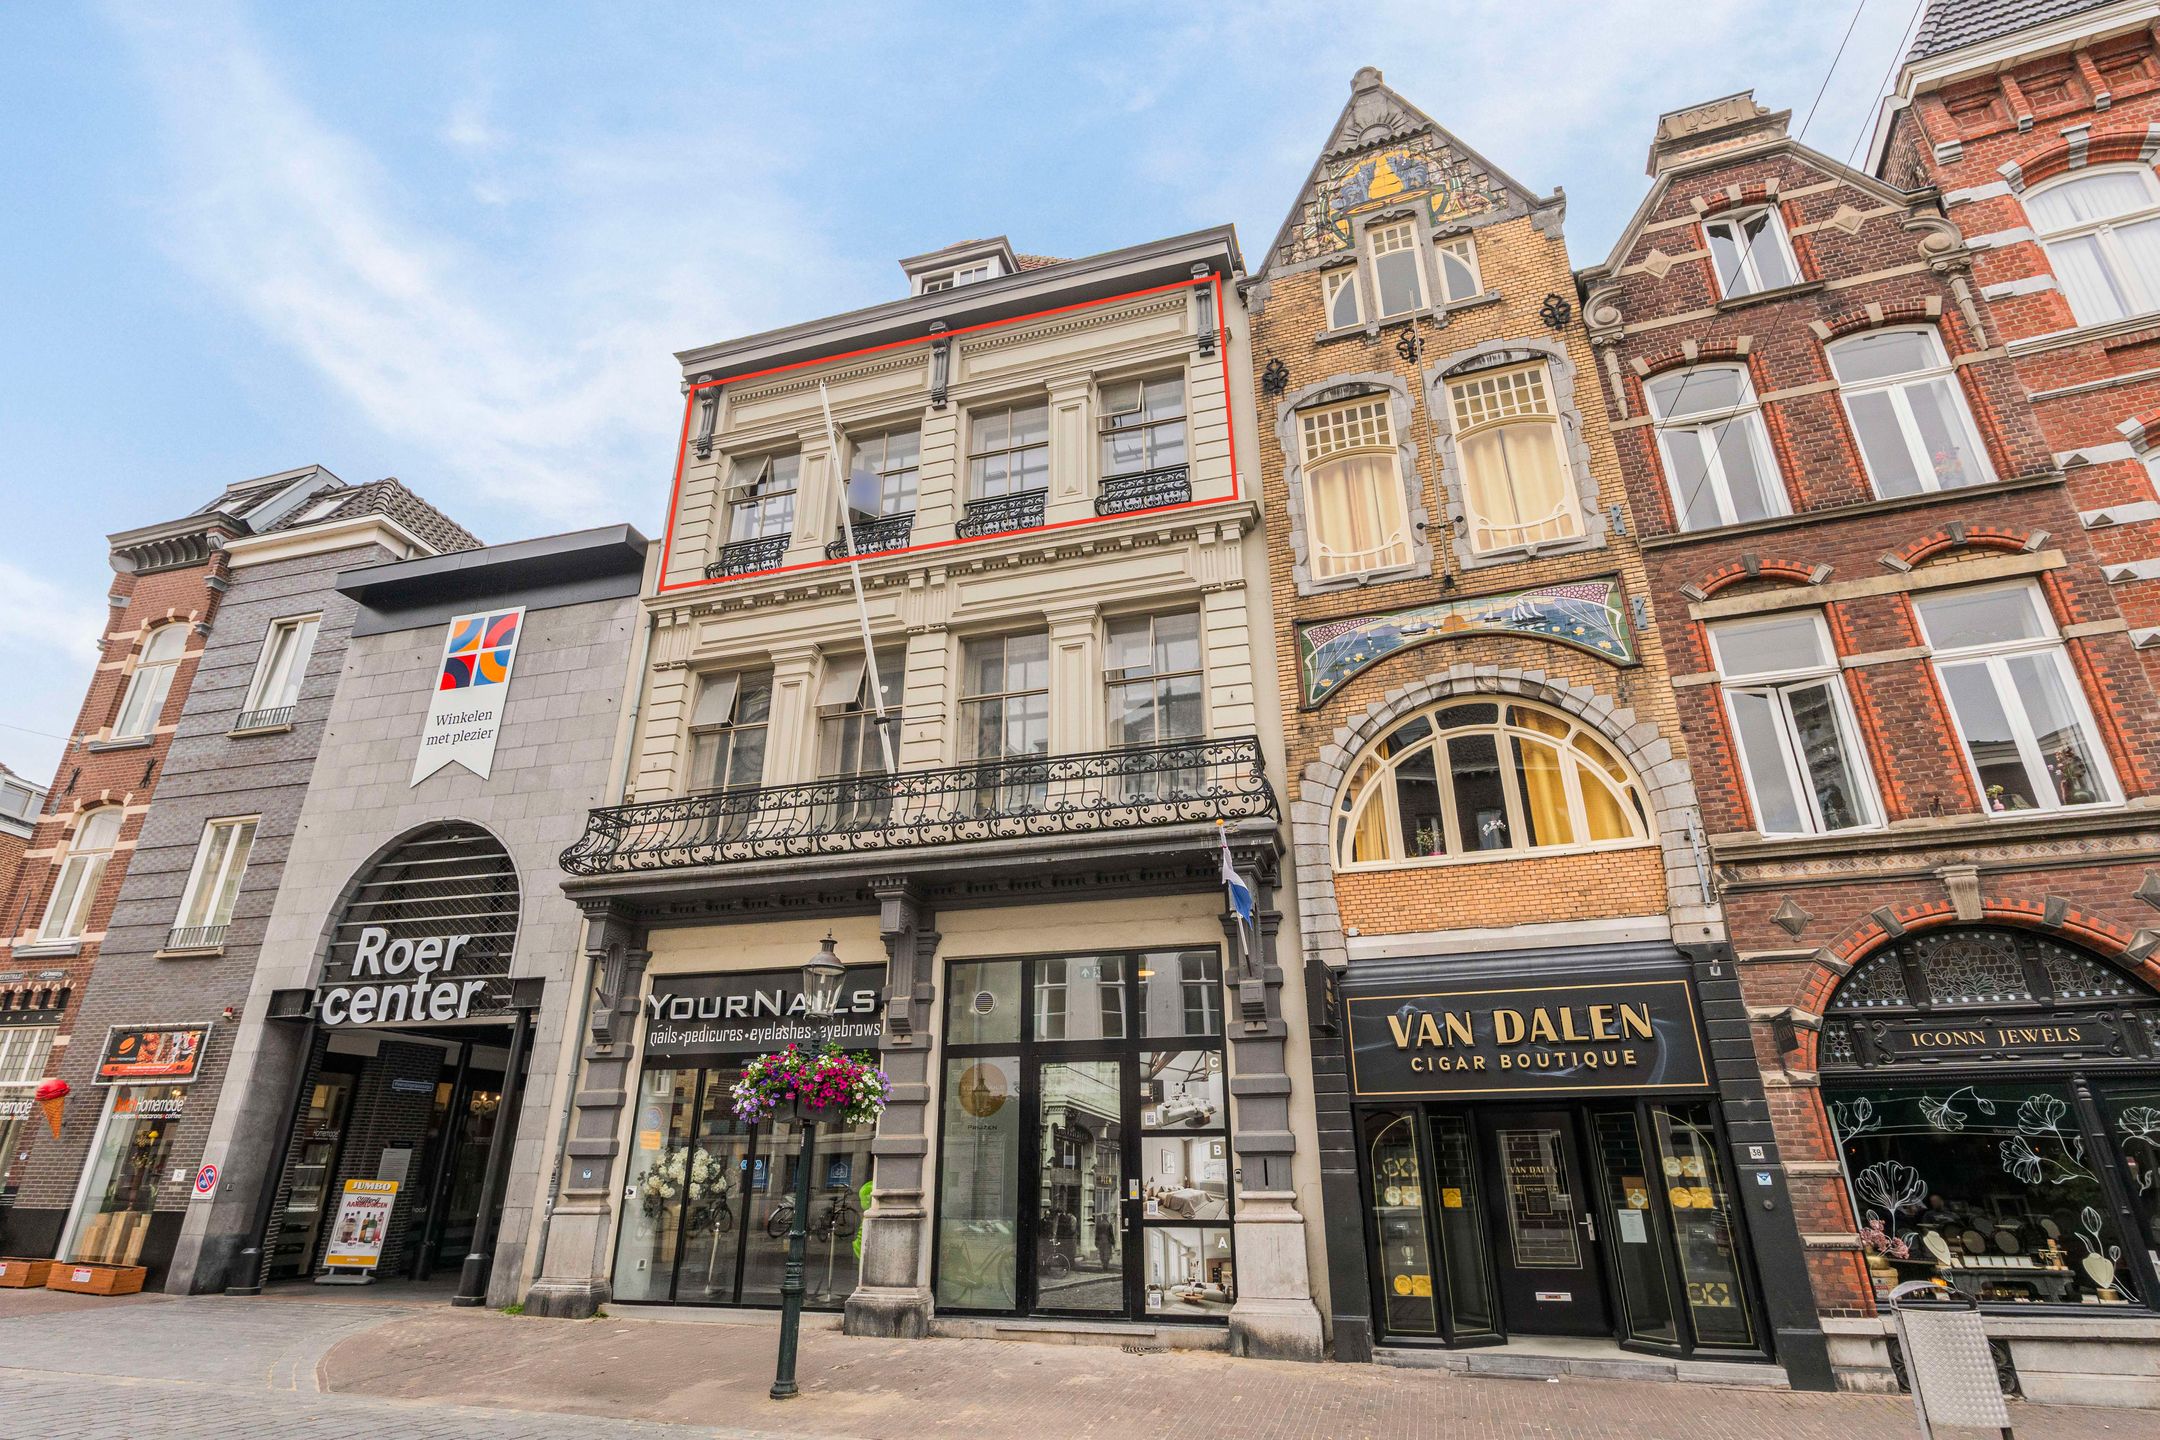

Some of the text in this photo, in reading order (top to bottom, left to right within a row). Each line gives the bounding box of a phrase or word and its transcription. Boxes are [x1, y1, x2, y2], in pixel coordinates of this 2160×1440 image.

[436, 710, 492, 726] Winkelen
[426, 728, 493, 745] met plezier
[351, 927, 471, 976] Roer
[322, 972, 487, 1025] center
[1387, 1002, 1655, 1048] VAN DALEN
[1911, 1027, 2081, 1047] ICONN JEWELS
[1209, 1056, 1219, 1068] C
[1411, 1050, 1637, 1072] CIGAR BOUTIQUE
[1213, 1144, 1222, 1156] B
[1752, 1148, 1762, 1157] 38
[1510, 1166, 1527, 1174] VAN
[352, 1181, 391, 1191] JUMBO
[1217, 1236, 1228, 1249] A
